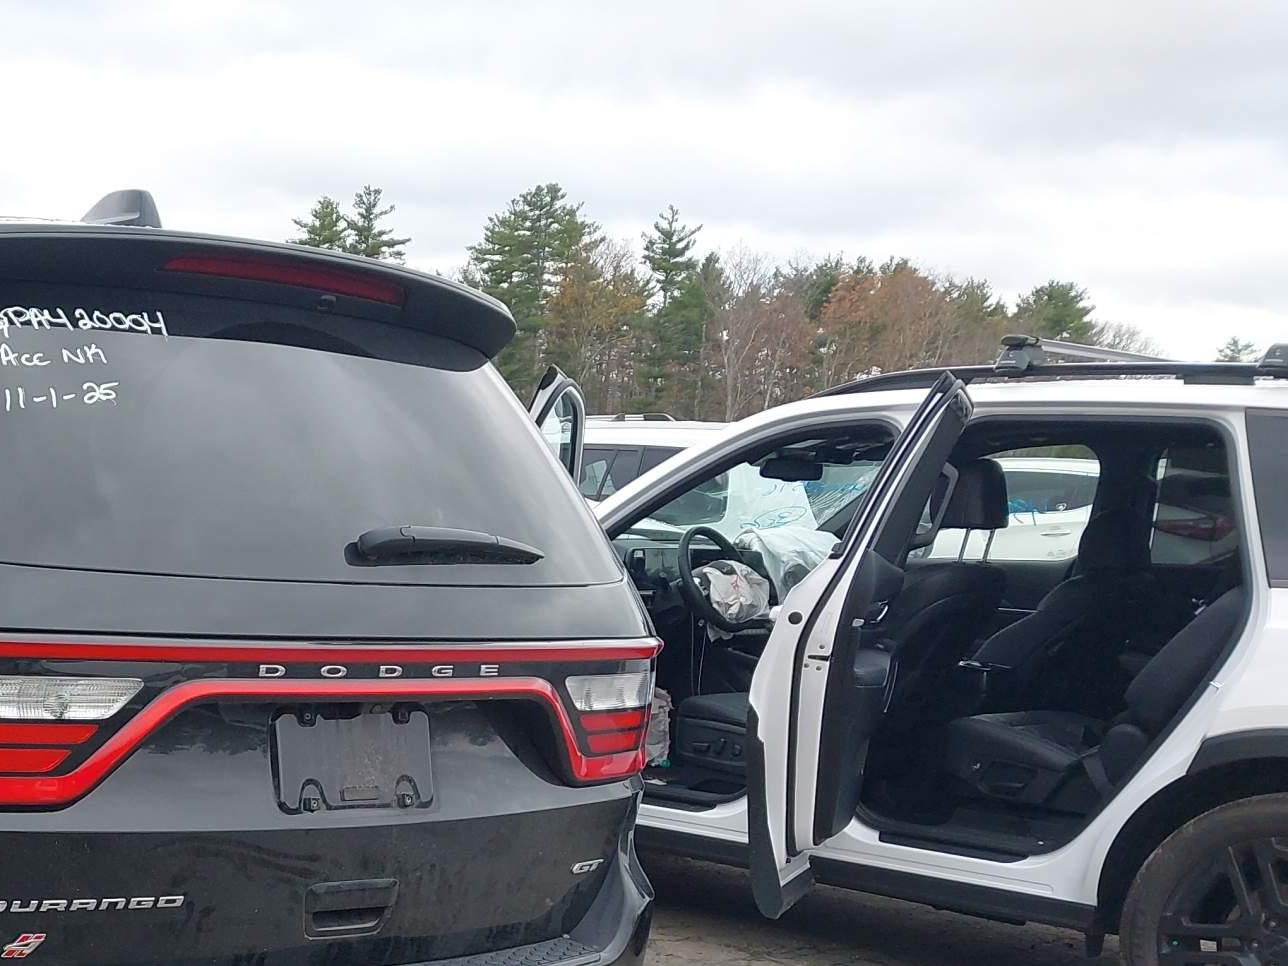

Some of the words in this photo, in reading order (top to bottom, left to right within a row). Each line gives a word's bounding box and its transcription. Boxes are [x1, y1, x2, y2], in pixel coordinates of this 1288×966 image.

[5, 382, 119, 412] 11-1-25
[258, 664, 500, 678] DODGE
[572, 858, 605, 874] GT
